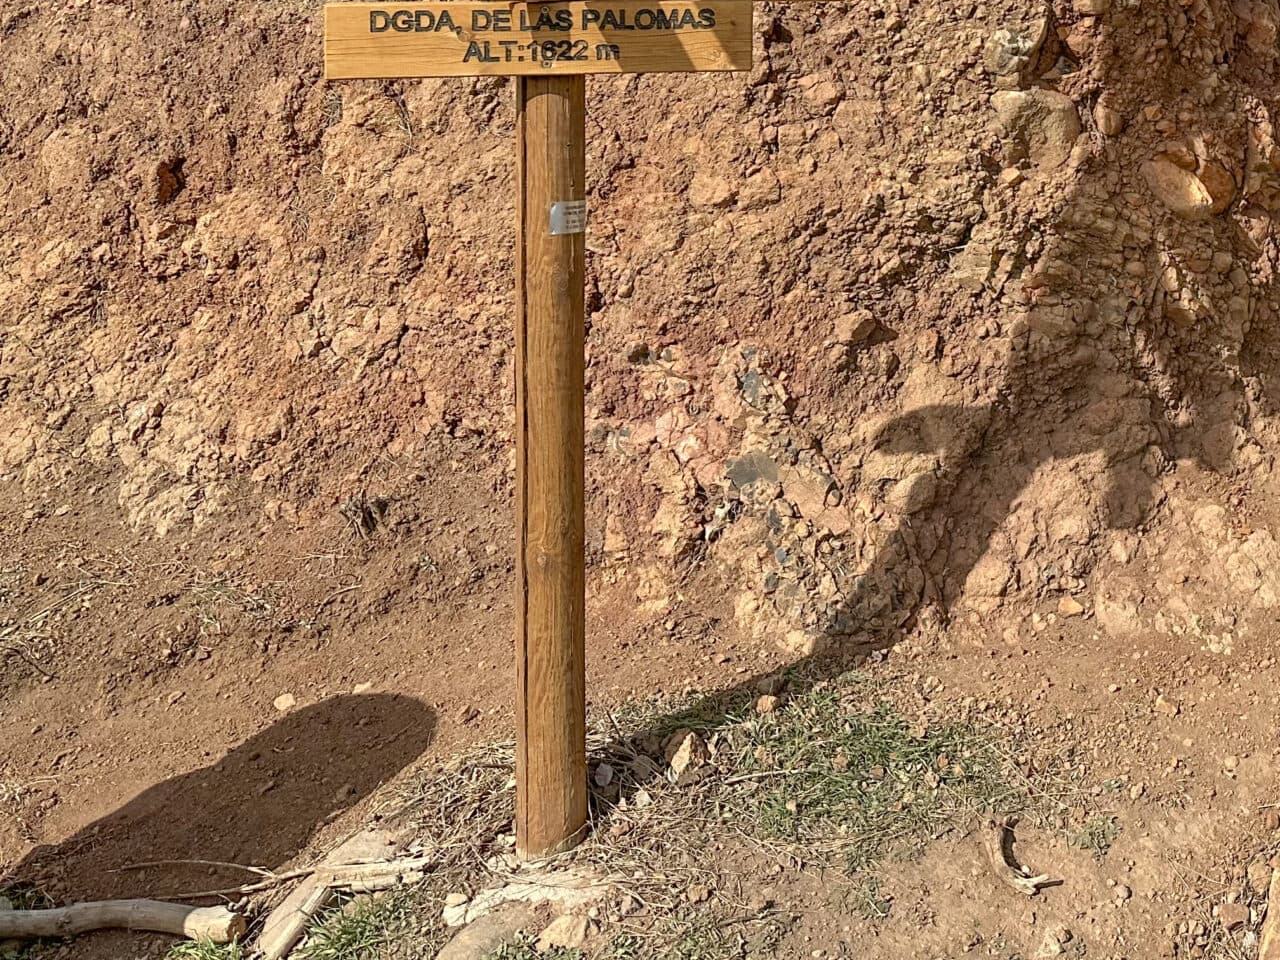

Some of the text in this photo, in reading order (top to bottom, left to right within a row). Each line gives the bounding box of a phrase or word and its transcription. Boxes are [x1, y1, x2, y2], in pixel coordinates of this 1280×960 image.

[471, 10, 511, 31] DE
[519, 9, 572, 31] LAS
[581, 8, 717, 31] PALOMAS
[595, 43, 620, 60] m
